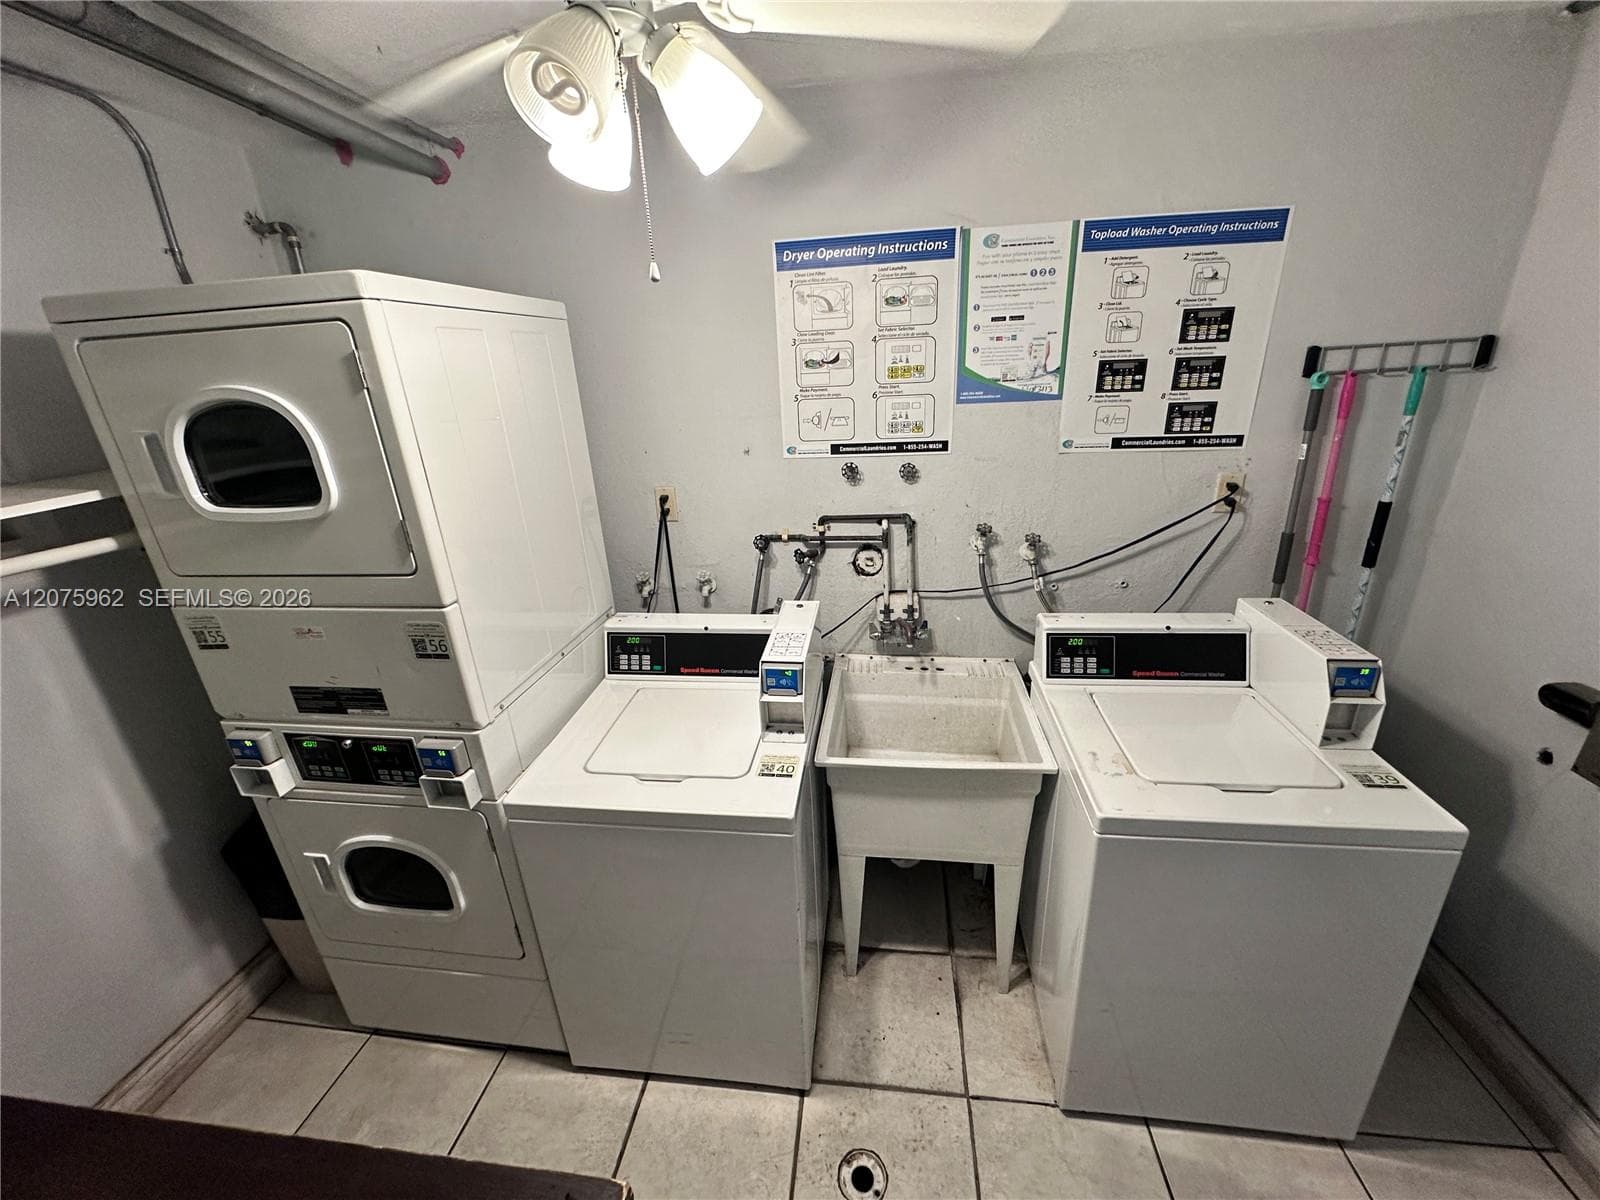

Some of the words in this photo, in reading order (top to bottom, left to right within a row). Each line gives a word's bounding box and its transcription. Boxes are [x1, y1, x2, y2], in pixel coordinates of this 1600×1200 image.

[1090, 228, 1128, 241] Topload
[1131, 226, 1167, 237] Washer
[1168, 222, 1218, 236] Operating
[1219, 219, 1280, 232] Instructions
[783, 250, 814, 264] Dryer
[816, 244, 875, 261] Operating
[878, 240, 948, 254] Instructions
[1184, 252, 1189, 260] 2
[872, 274, 877, 282] 2
[790, 280, 793, 288] 1
[792, 338, 797, 347] 3
[794, 394, 799, 402] 5
[872, 391, 878, 399] 6
[1160, 392, 1166, 400] 8
[207, 631, 226, 643] 55
[429, 639, 448, 653] 56
[776, 765, 795, 773] 40
[1373, 774, 1400, 784] 39
